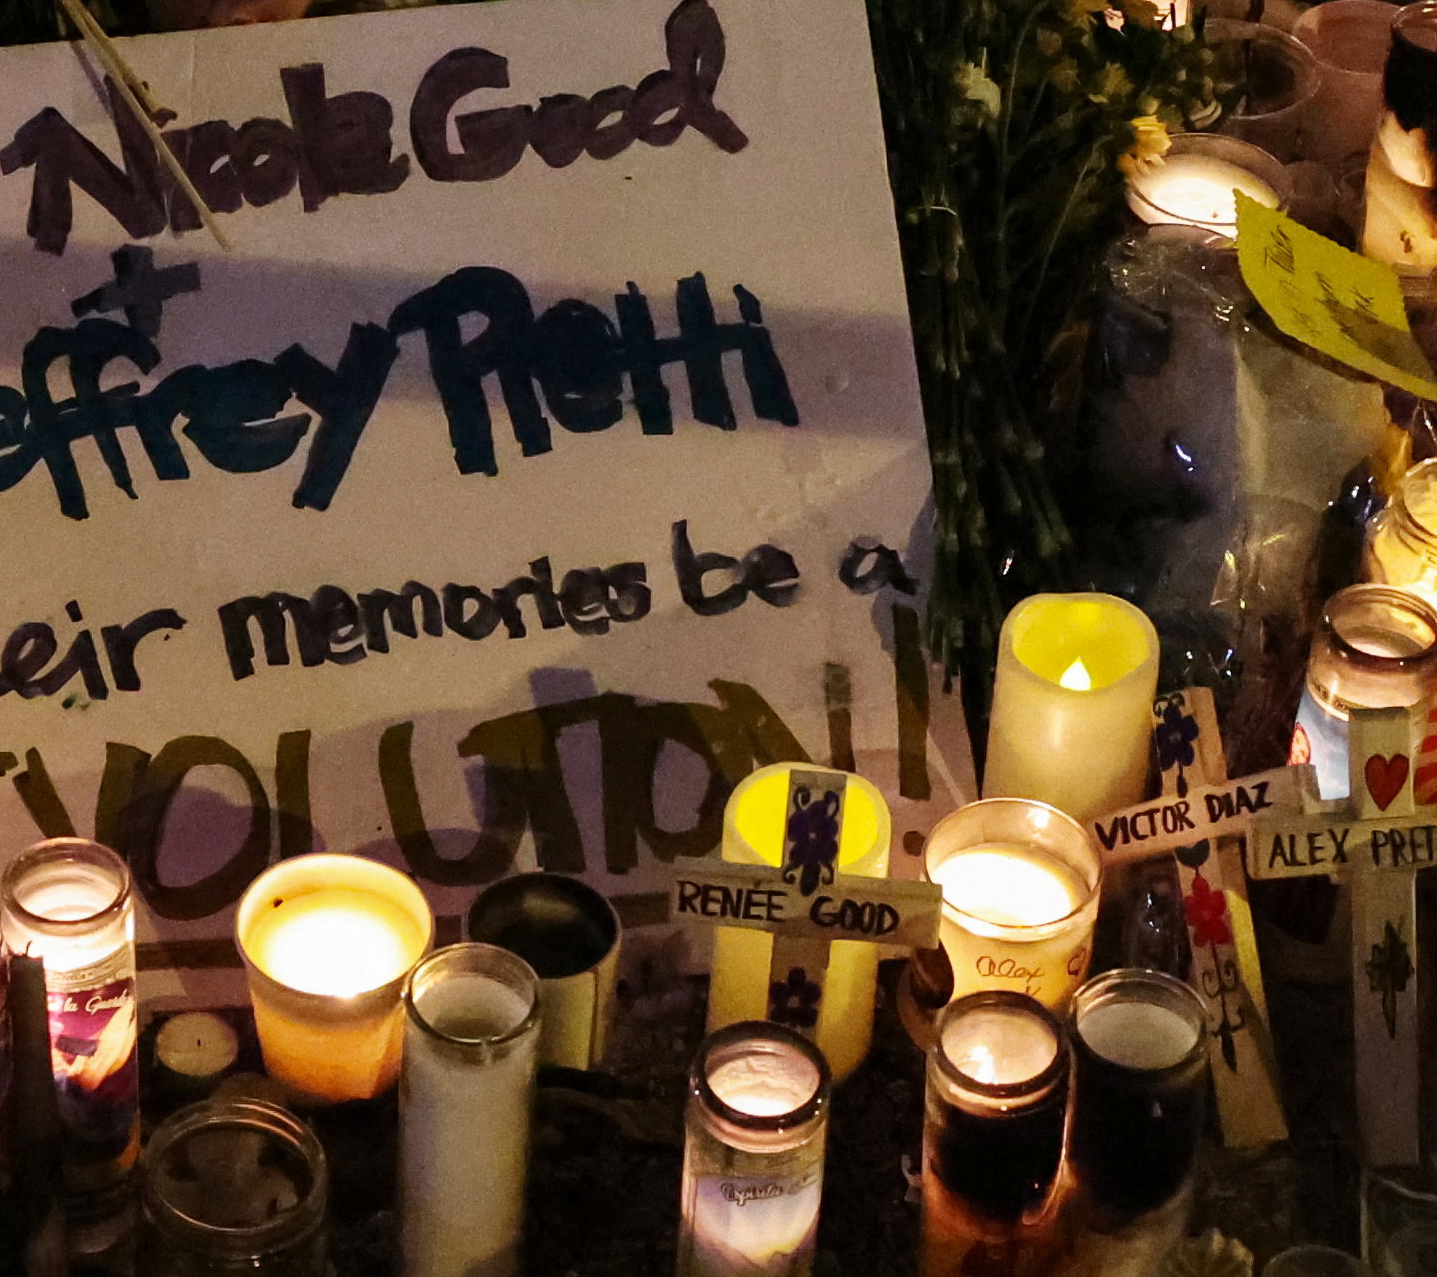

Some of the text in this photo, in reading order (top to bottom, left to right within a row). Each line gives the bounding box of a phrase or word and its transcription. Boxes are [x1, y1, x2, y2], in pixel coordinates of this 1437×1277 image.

[0, 62, 413, 255] Nicole
[393, 266, 801, 477] Pretti
[218, 551, 652, 683] memories
[668, 518, 801, 623] be
[838, 538, 918, 600] a
[1095, 781, 1275, 851] VICTOR DIAZ
[1268, 829, 1348, 869] ALEX
[677, 879, 900, 937] RENÉE GOOD
